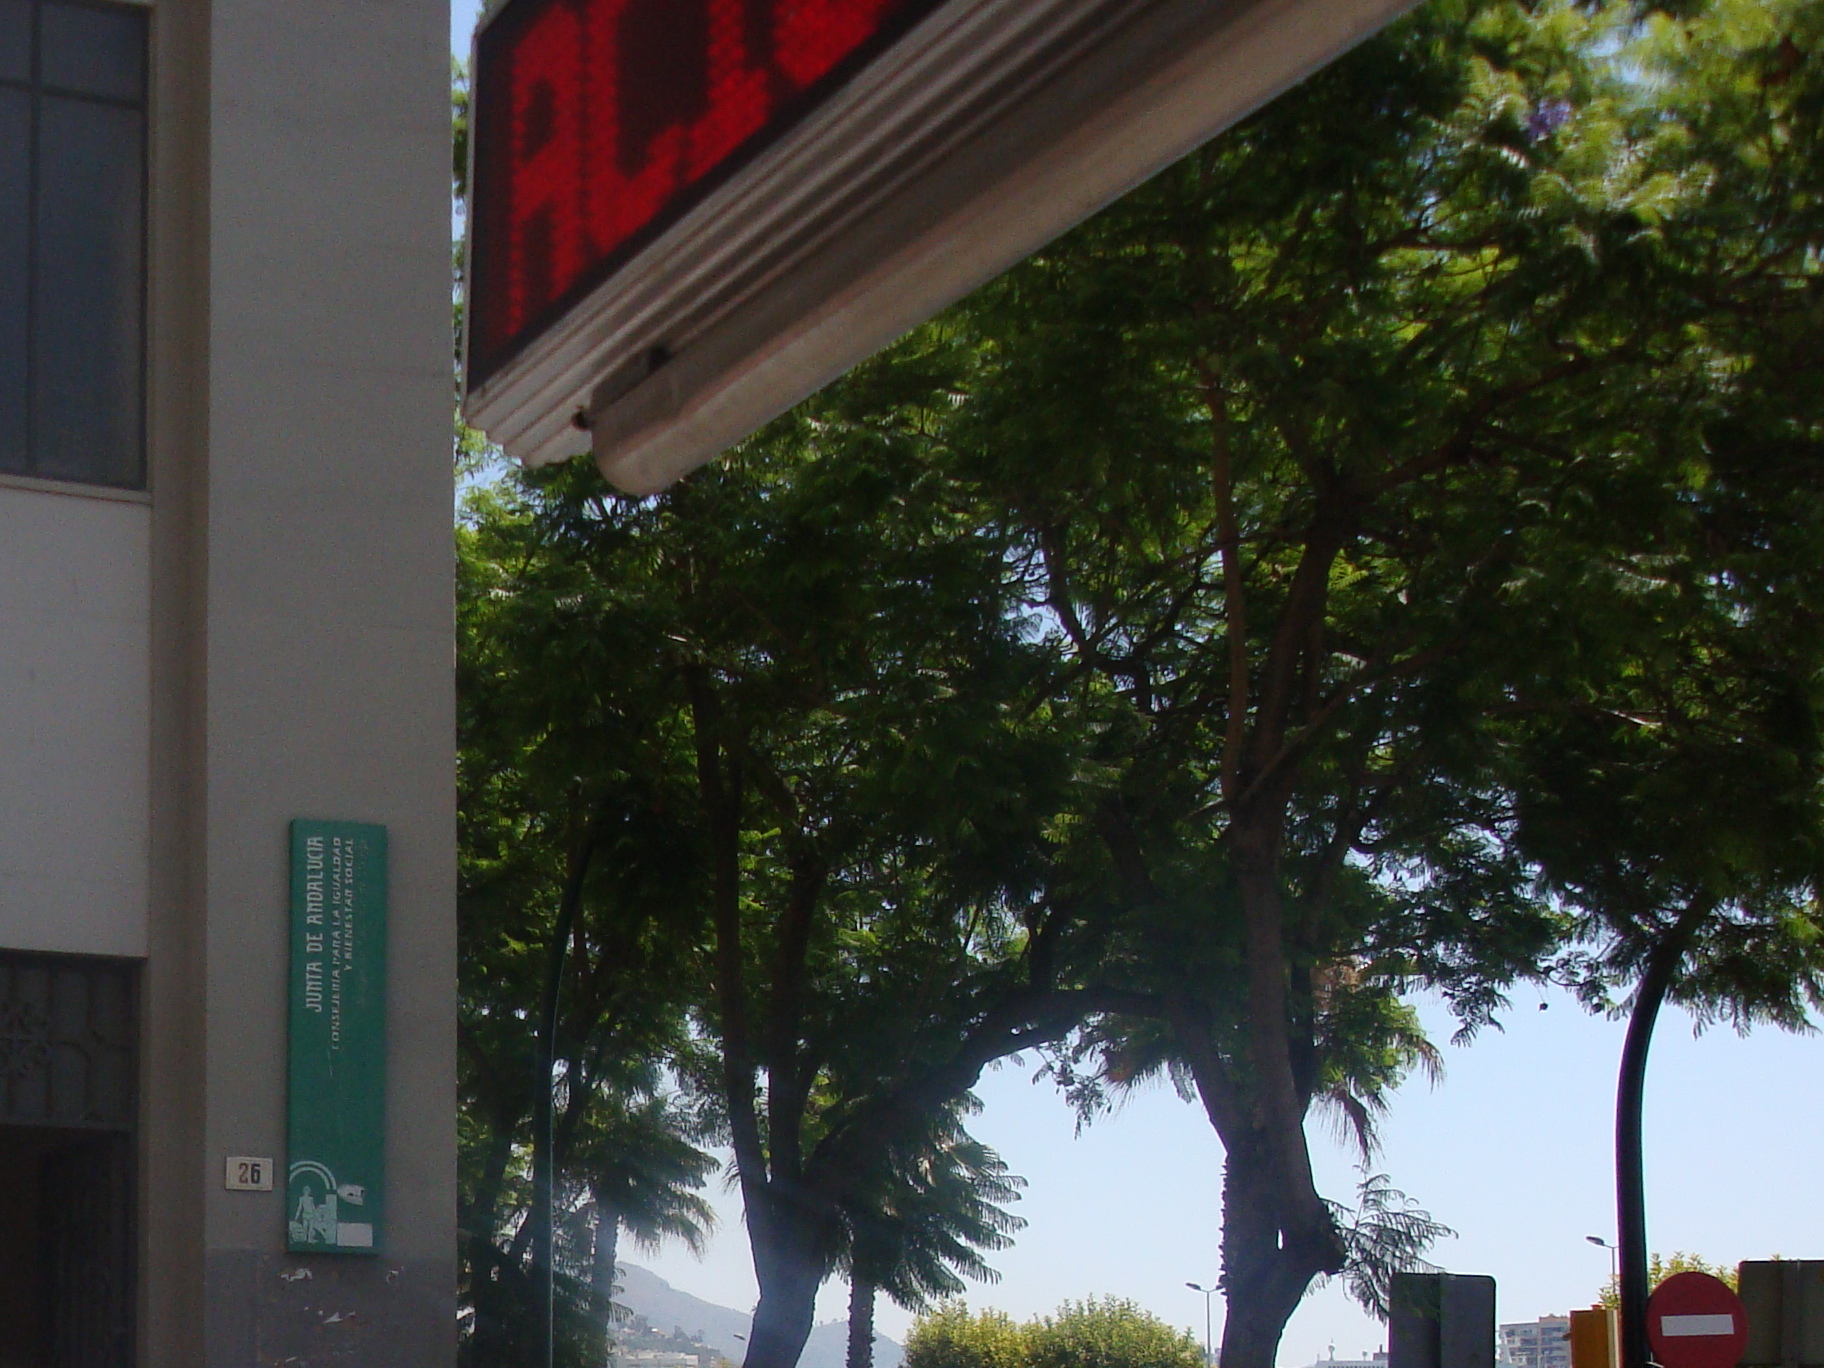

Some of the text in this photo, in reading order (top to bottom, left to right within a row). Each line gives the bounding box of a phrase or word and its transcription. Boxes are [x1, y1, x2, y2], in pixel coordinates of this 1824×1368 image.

[332, 837, 342, 904] IGUALDAD
[344, 839, 354, 884] SOCIAL
[306, 836, 324, 1013] JUNTA DE ANDALUCIA
[332, 910, 341, 926] LA
[344, 889, 354, 959] BIENESTAR
[332, 930, 341, 965] PARA
[238, 1162, 262, 1185] 26
